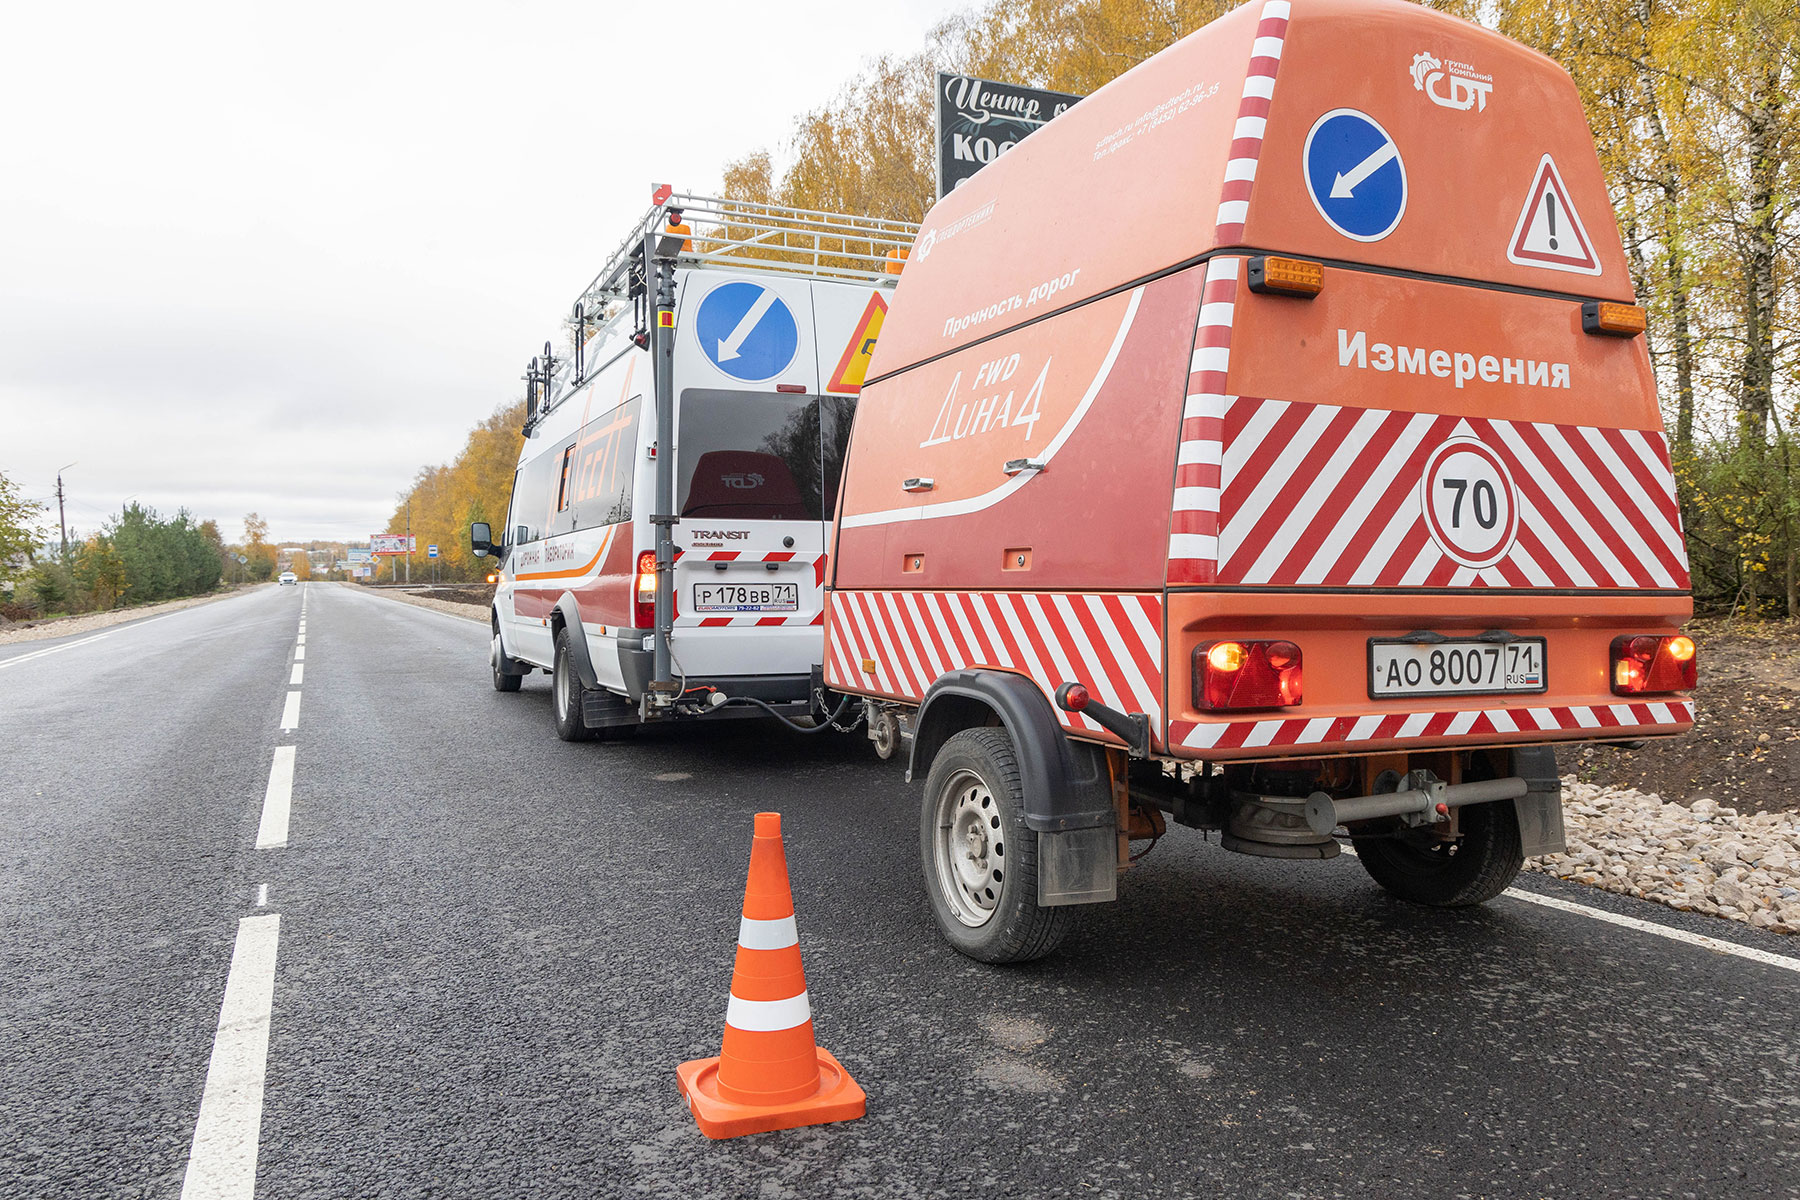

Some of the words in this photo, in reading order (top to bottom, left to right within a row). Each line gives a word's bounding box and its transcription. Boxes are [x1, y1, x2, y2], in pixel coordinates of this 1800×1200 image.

[1449, 65, 1493, 82] КОМПАНИЙ
[945, 76, 1041, 124] Центр
[1135, 81, 1204, 127] info@sdtech.ru
[943, 294, 1023, 338] Прочность
[1025, 268, 1080, 308] дорог
[972, 353, 1021, 391] FWD
[1337, 328, 1571, 389] Измерения
[1442, 478, 1498, 530] 70
[691, 530, 751, 540] TRANSIT
[1430, 649, 1499, 686] 8007
[1507, 646, 1533, 673] 71
[1506, 674, 1525, 685] RUS
